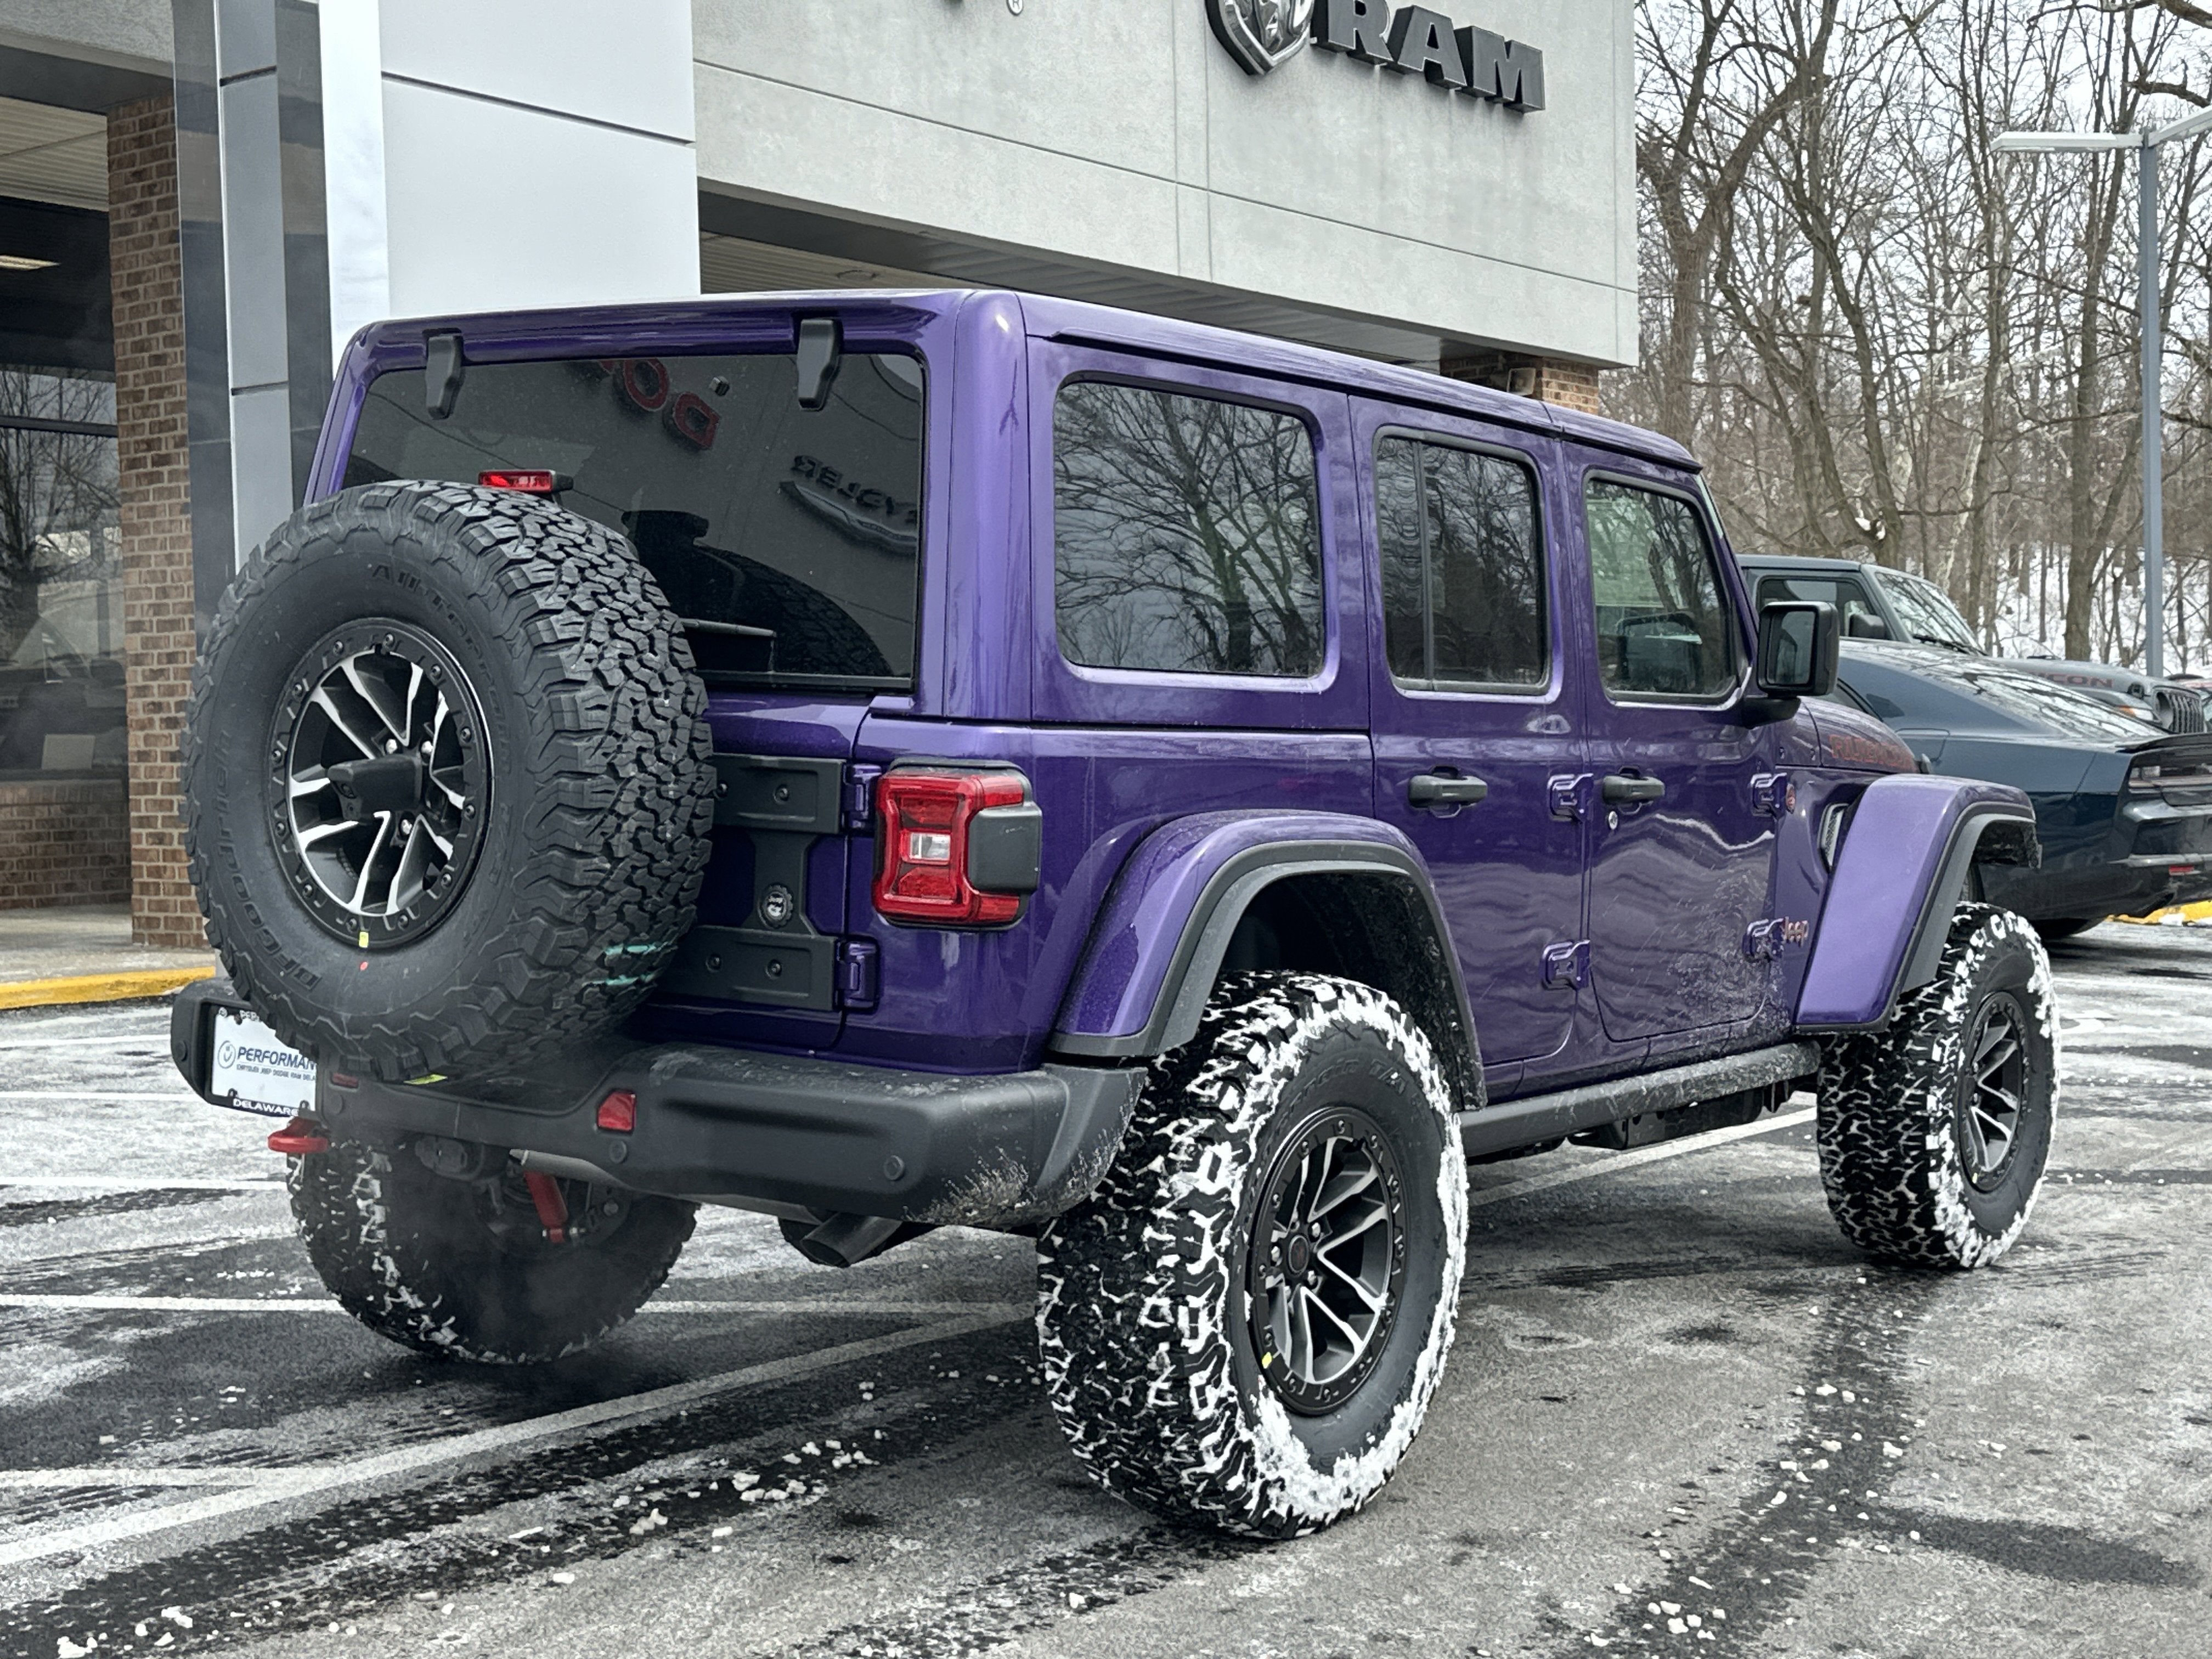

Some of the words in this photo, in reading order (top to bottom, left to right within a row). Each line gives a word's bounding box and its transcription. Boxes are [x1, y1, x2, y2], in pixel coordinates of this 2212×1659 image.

[1315, 0, 1545, 112] RAM
[1781, 916, 1809, 948] Jeep
[233, 1098, 299, 1116] DELAWARE
